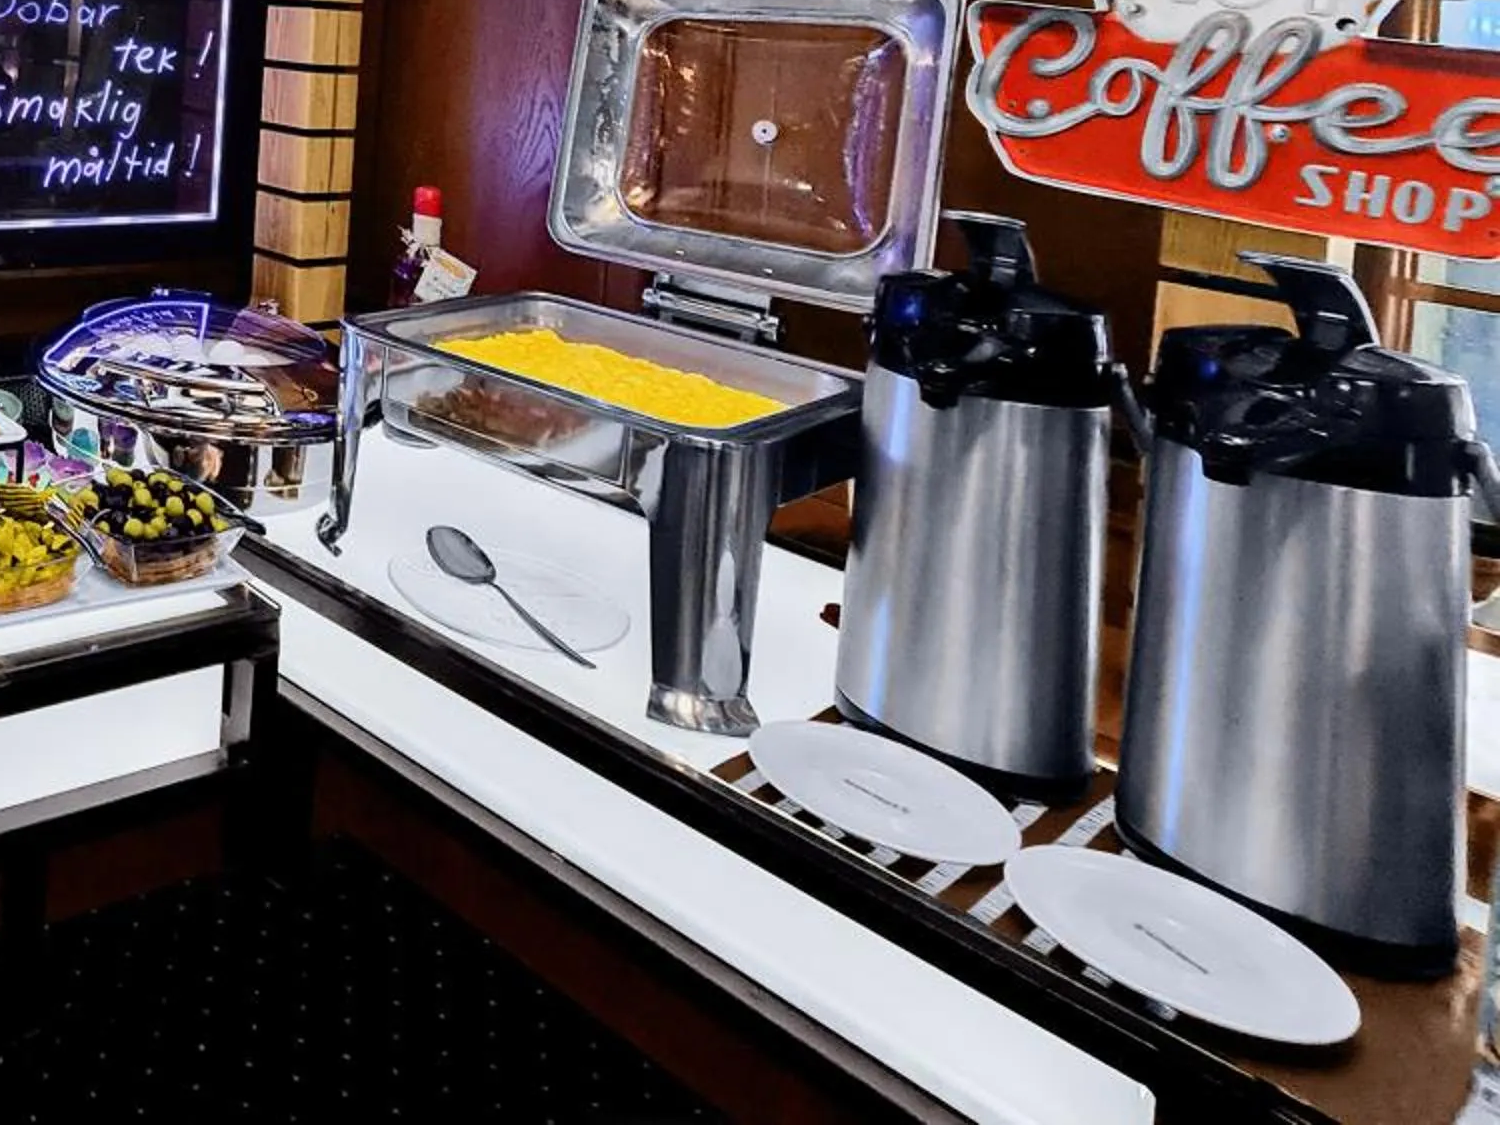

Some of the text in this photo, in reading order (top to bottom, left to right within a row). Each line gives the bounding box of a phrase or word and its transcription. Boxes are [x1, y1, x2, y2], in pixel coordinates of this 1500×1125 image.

[112, 38, 180, 74] tek
[976, 8, 1500, 191] Coffee
[1292, 163, 1492, 234] SHOP
